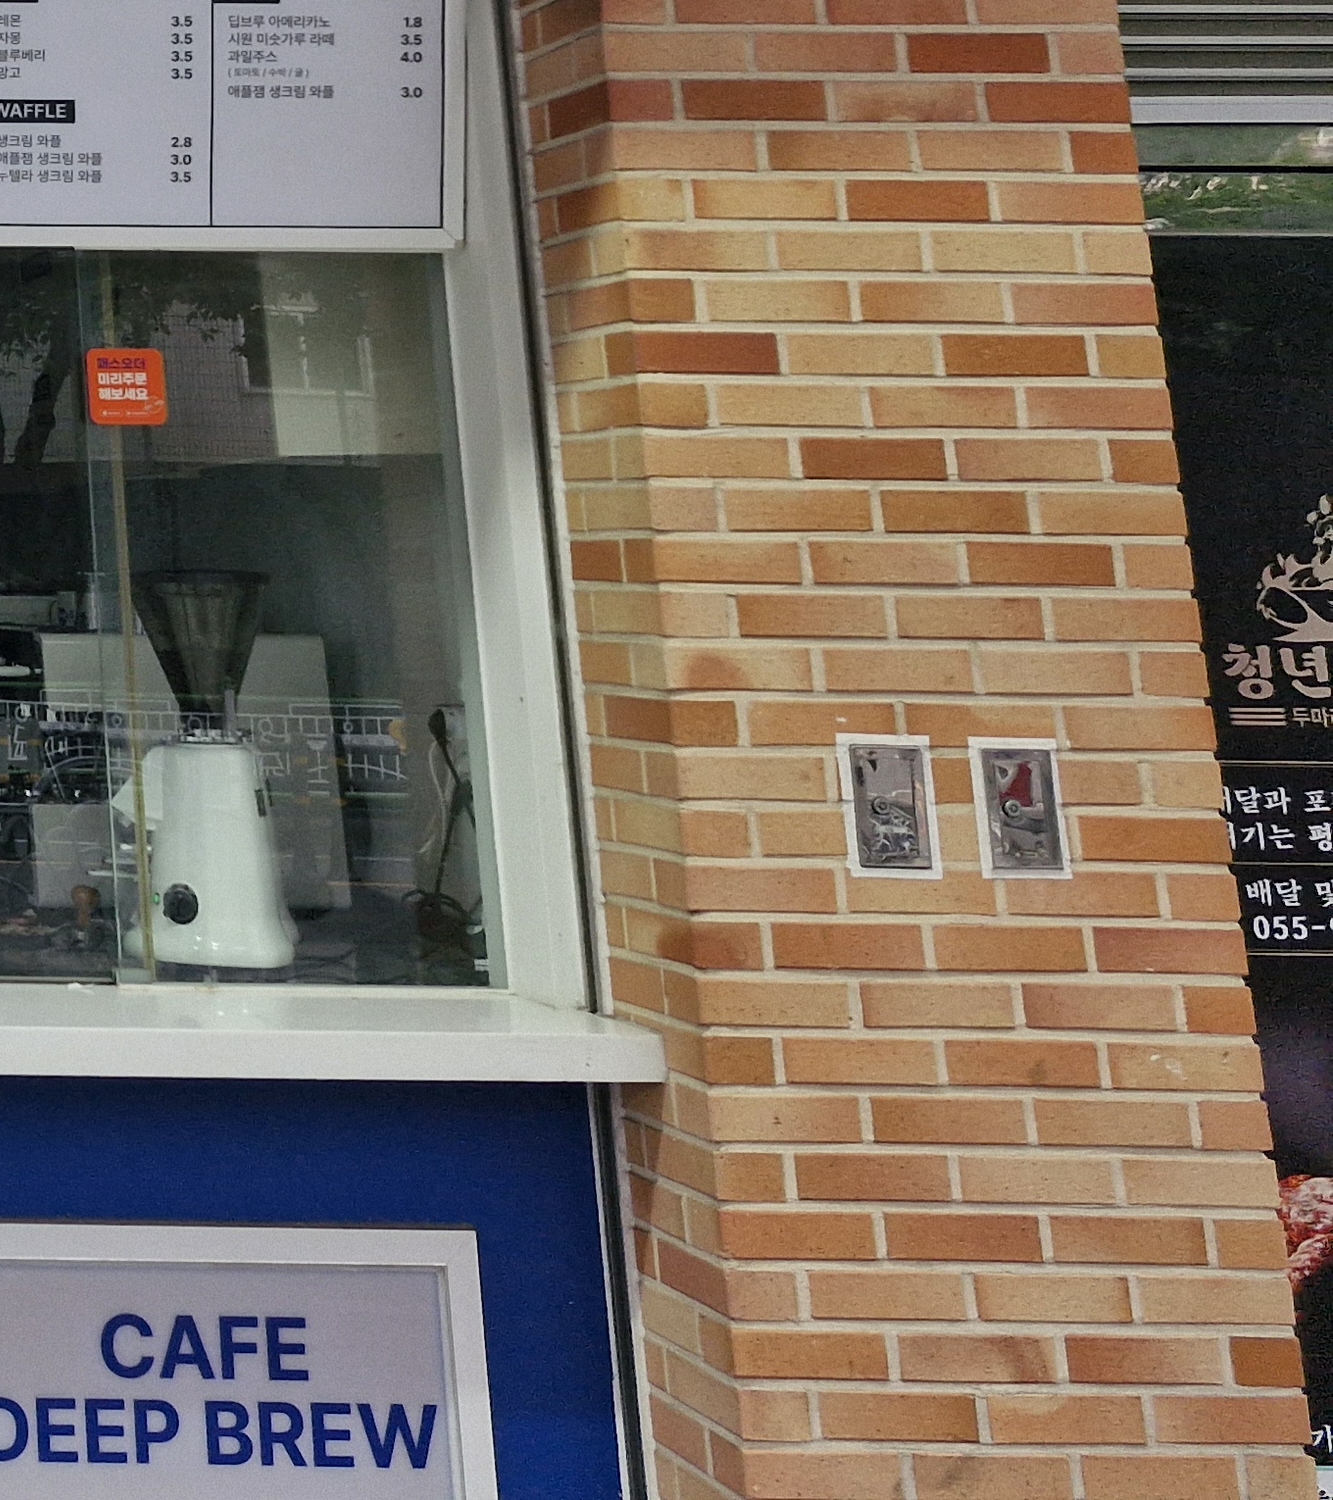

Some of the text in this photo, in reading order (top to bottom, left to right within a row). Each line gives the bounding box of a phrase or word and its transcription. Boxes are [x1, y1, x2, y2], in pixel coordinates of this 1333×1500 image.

[171, 16, 192, 26] 3.5
[228, 16, 330, 28] 딥브루 아메리카노
[403, 17, 422, 27] 1.8
[171, 34, 192, 44] 3.5
[228, 33, 334, 46] 시원 미숫가루 라떼
[401, 34, 422, 45] 3.5
[171, 51, 192, 62] 3.5
[228, 51, 277, 62] 과일주스
[400, 52, 422, 62] 4.0
[171, 69, 192, 79] 3.5
[269, 85, 305, 98] 생크림
[401, 87, 422, 98] 3.0
[37, 135, 61, 147] 와플
[171, 137, 192, 147] 2.8
[37, 152, 102, 165] 생크림 와플
[170, 155, 192, 165] 3.0
[37, 170, 102, 182] 생크림 와플
[170, 172, 191, 182] 3.5
[97, 373, 147, 385] 미리주문
[98, 388, 148, 400] 해보세요
[1292, 707, 1333, 728] 두마
[1245, 878, 1302, 907] 배달
[1253, 915, 1333, 940] 055-
[100, 1312, 307, 1383] CAFE
[206, 1401, 436, 1470] BREW
